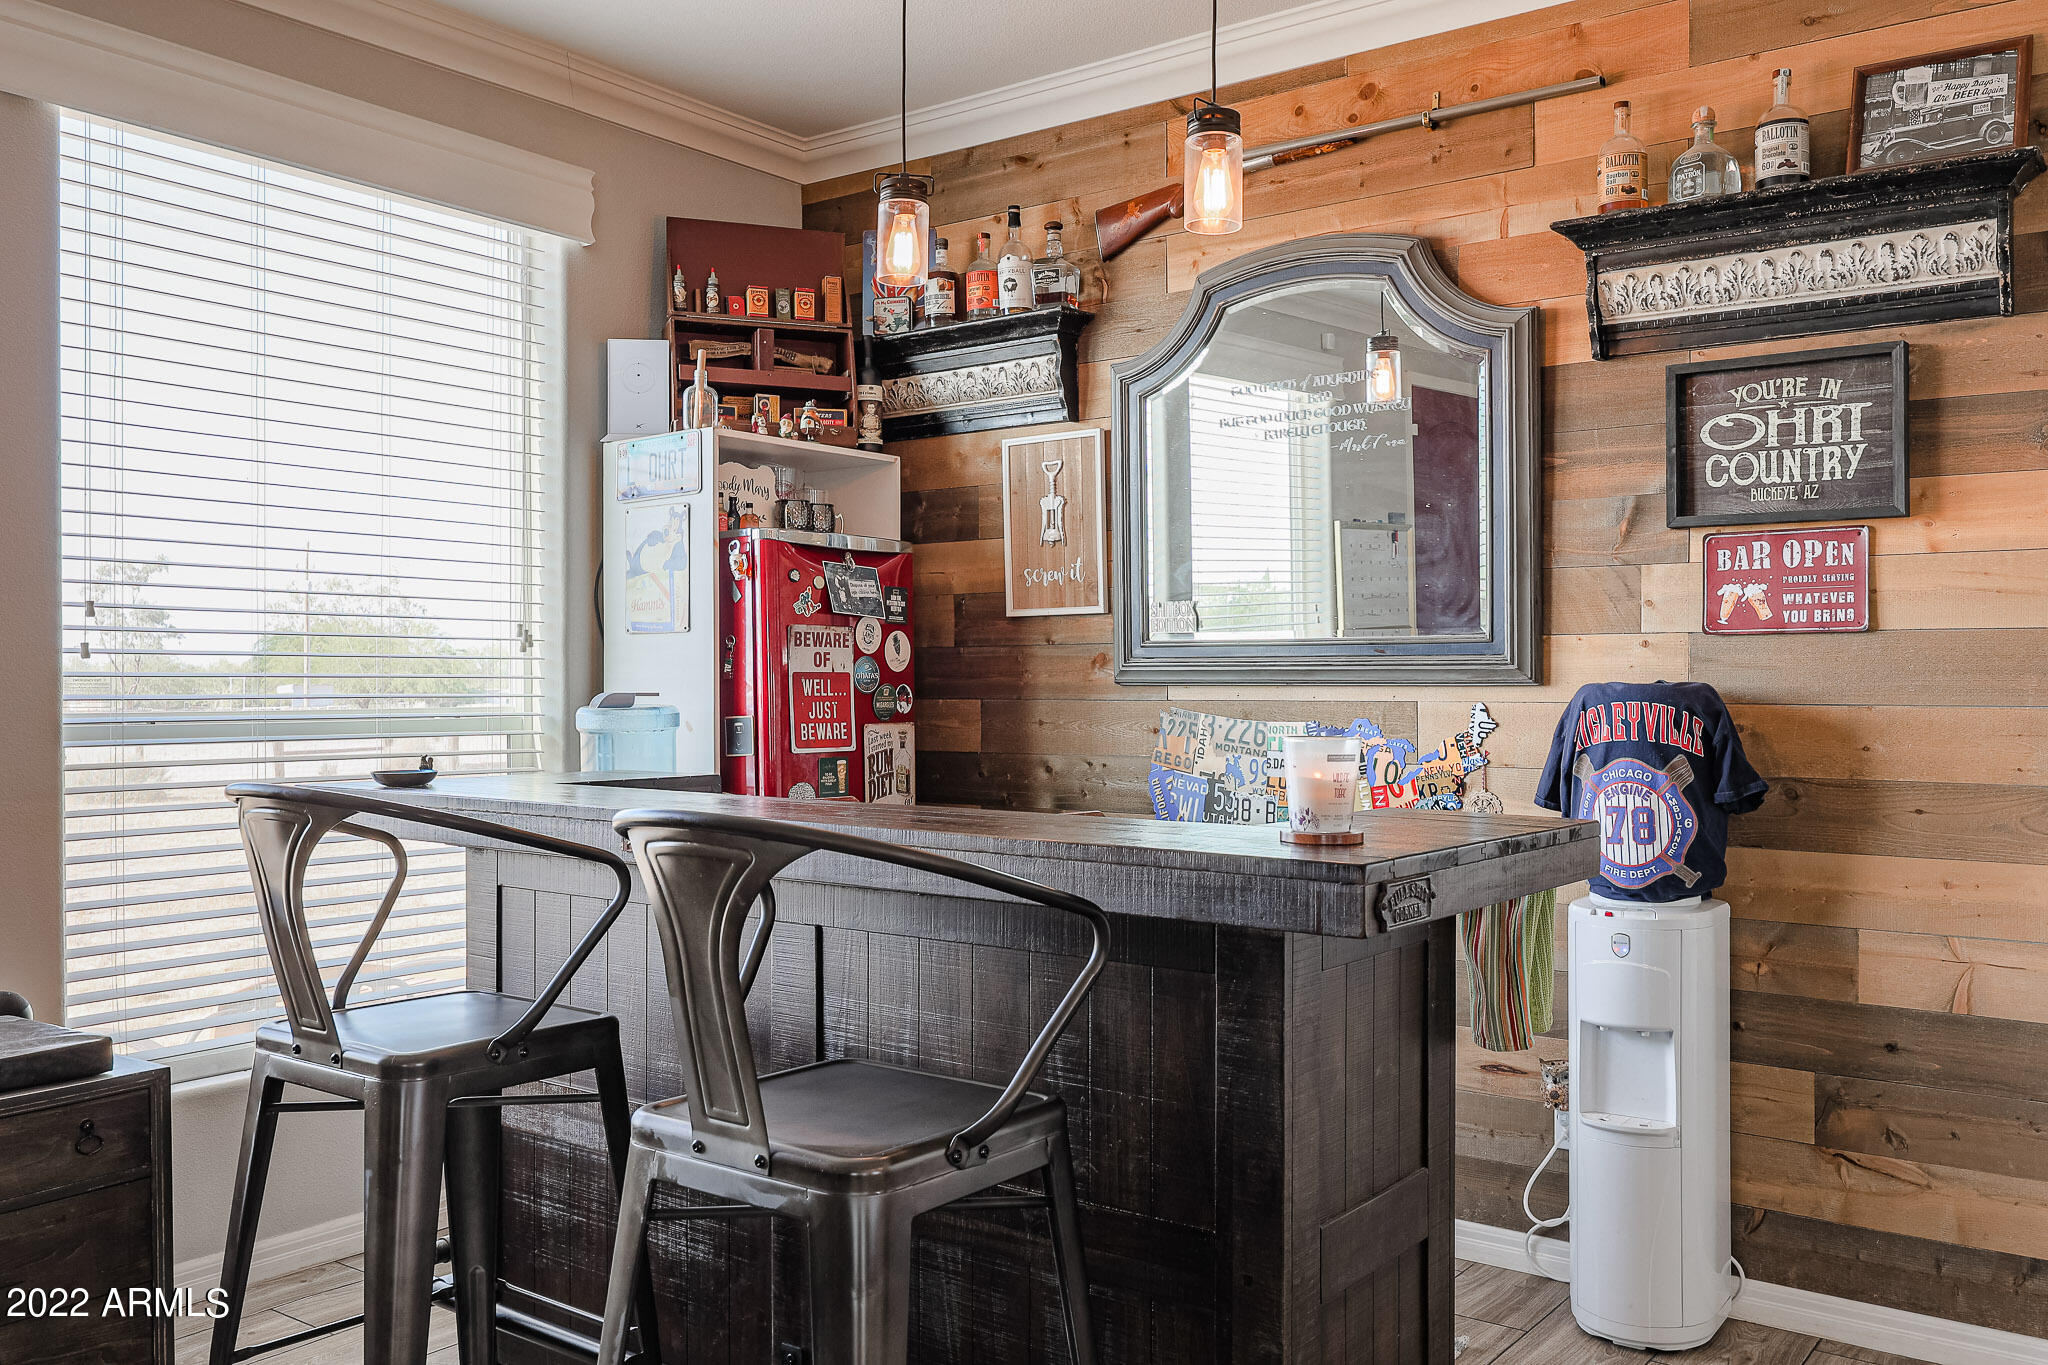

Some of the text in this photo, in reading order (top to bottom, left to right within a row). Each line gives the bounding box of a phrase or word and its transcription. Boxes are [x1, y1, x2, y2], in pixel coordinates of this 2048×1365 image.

[1943, 79, 1994, 91] Happy Days
[1952, 89, 1980, 100] BEER
[1980, 86, 2005, 96] Again
[1762, 125, 1799, 142] BALLOTIN
[1605, 153, 1639, 169] BALLOTIN
[1762, 150, 1786, 160] Chocolate
[1606, 171, 1629, 180] Bourbon
[1728, 376, 1843, 407] YOU'RE IN
[1313, 404, 1351, 419] GOOD
[1700, 402, 1873, 450] OHRT
[1705, 443, 1869, 488] COUNTRY
[743, 478, 769, 500] Mary
[1750, 484, 1820, 502] BUCKEYE, AZ
[1716, 539, 1855, 571] BAR OPEN
[1024, 557, 1085, 587] screw it
[1782, 573, 1855, 584] PROUDLY SERVING
[1782, 591, 1855, 605] WHATEVER
[1782, 608, 1855, 623] YOU BRING
[1151, 618, 1195, 632] EDITION
[794, 631, 850, 648] BEWARE
[813, 652, 831, 668] OF
[801, 679, 847, 696] WELL...
[809, 701, 838, 719] JUST
[800, 722, 848, 740] BEWARE
[1356, 724, 1378, 737] GREAT
[1215, 742, 1268, 758] MONTANA
[867, 748, 894, 780] RUM
[1602, 768, 1652, 782] CHICAGO
[867, 772, 895, 803] DIET
[1603, 783, 1653, 802] ENGINE
[1151, 776, 1170, 821] IFORNIA
[1373, 788, 1387, 807] IN
[1606, 805, 1656, 845] 78
[1664, 792, 1683, 857] AMBULANCE
[1684, 818, 1693, 828] 6
[1604, 864, 1660, 879] FIRE DEPT.
